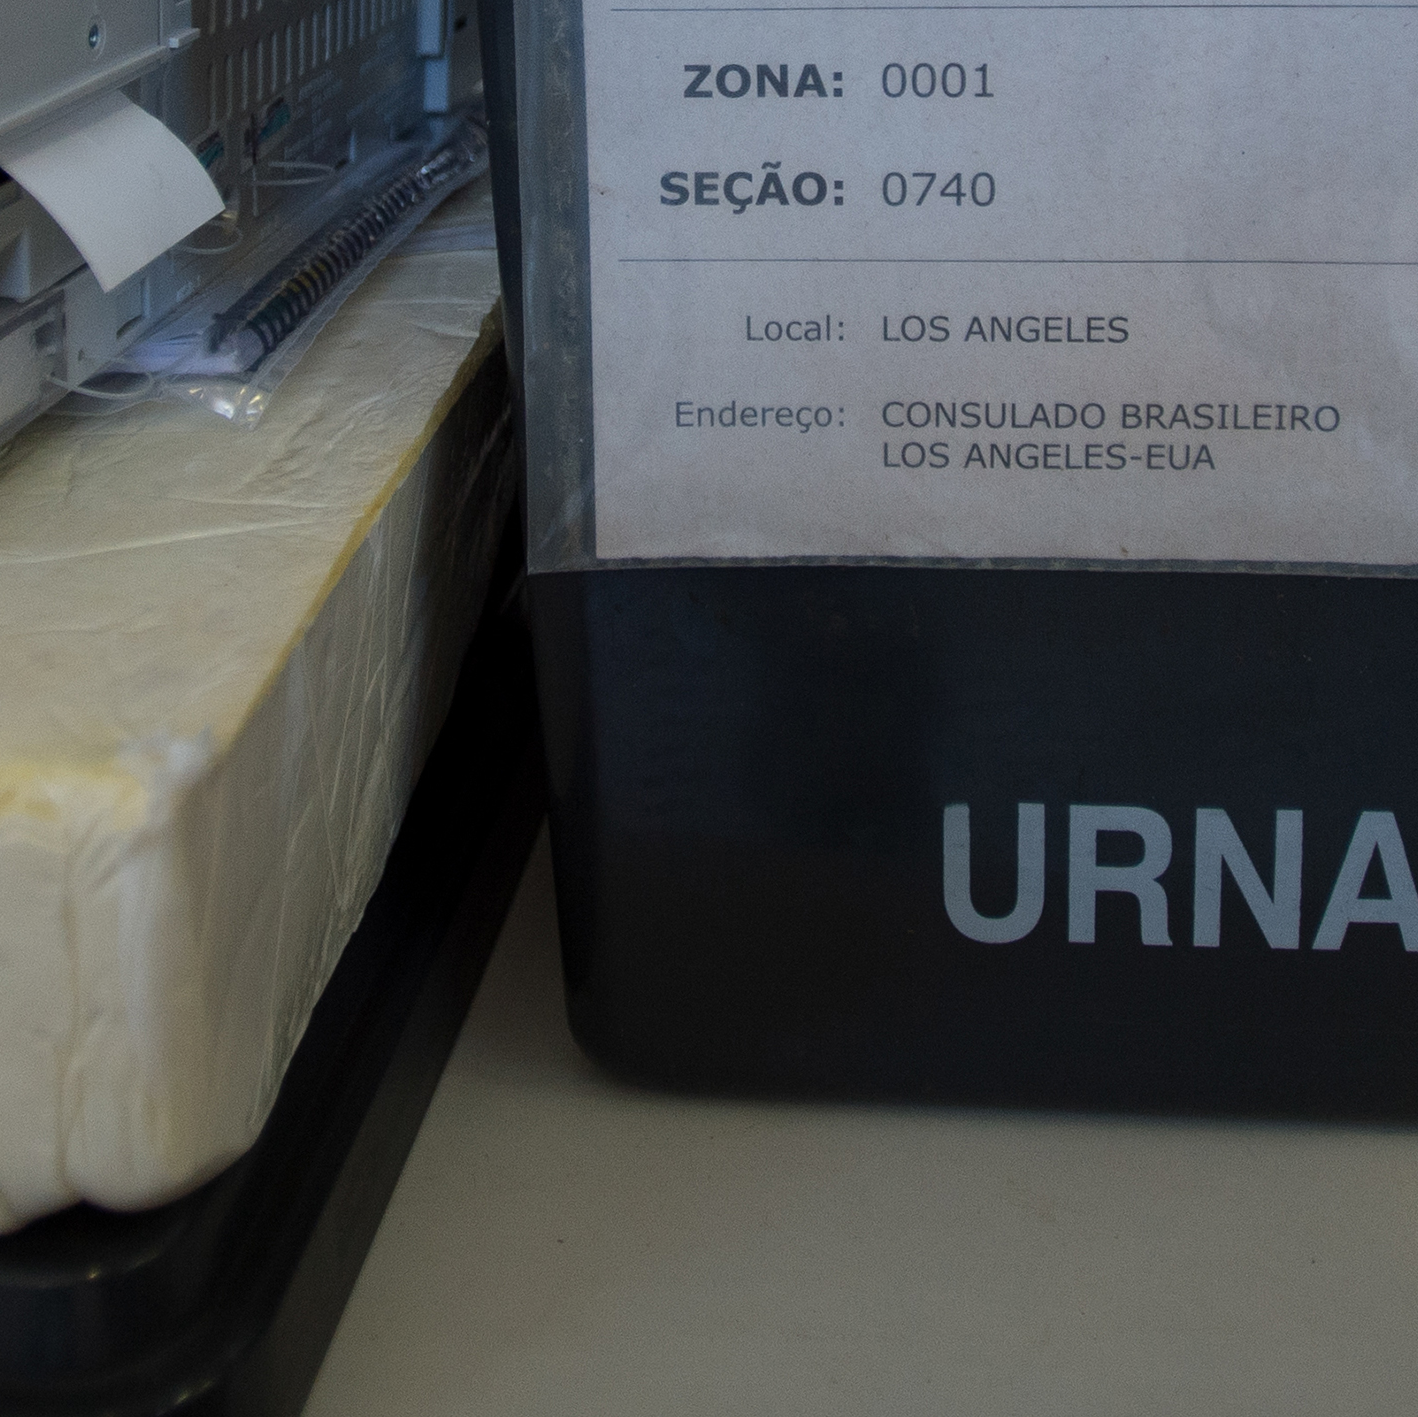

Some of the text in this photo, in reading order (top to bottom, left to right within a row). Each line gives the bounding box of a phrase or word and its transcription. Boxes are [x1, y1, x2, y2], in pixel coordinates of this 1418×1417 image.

[683, 61, 995, 99] ZONA: 0001
[659, 161, 997, 215] SEÇÃO: 0740
[745, 313, 1130, 345] Local: LOS ANGELES
[674, 399, 1341, 435] Endereço: CONSULADO BRASILEIRO
[882, 440, 1216, 472] LOS ANGELES-EUA
